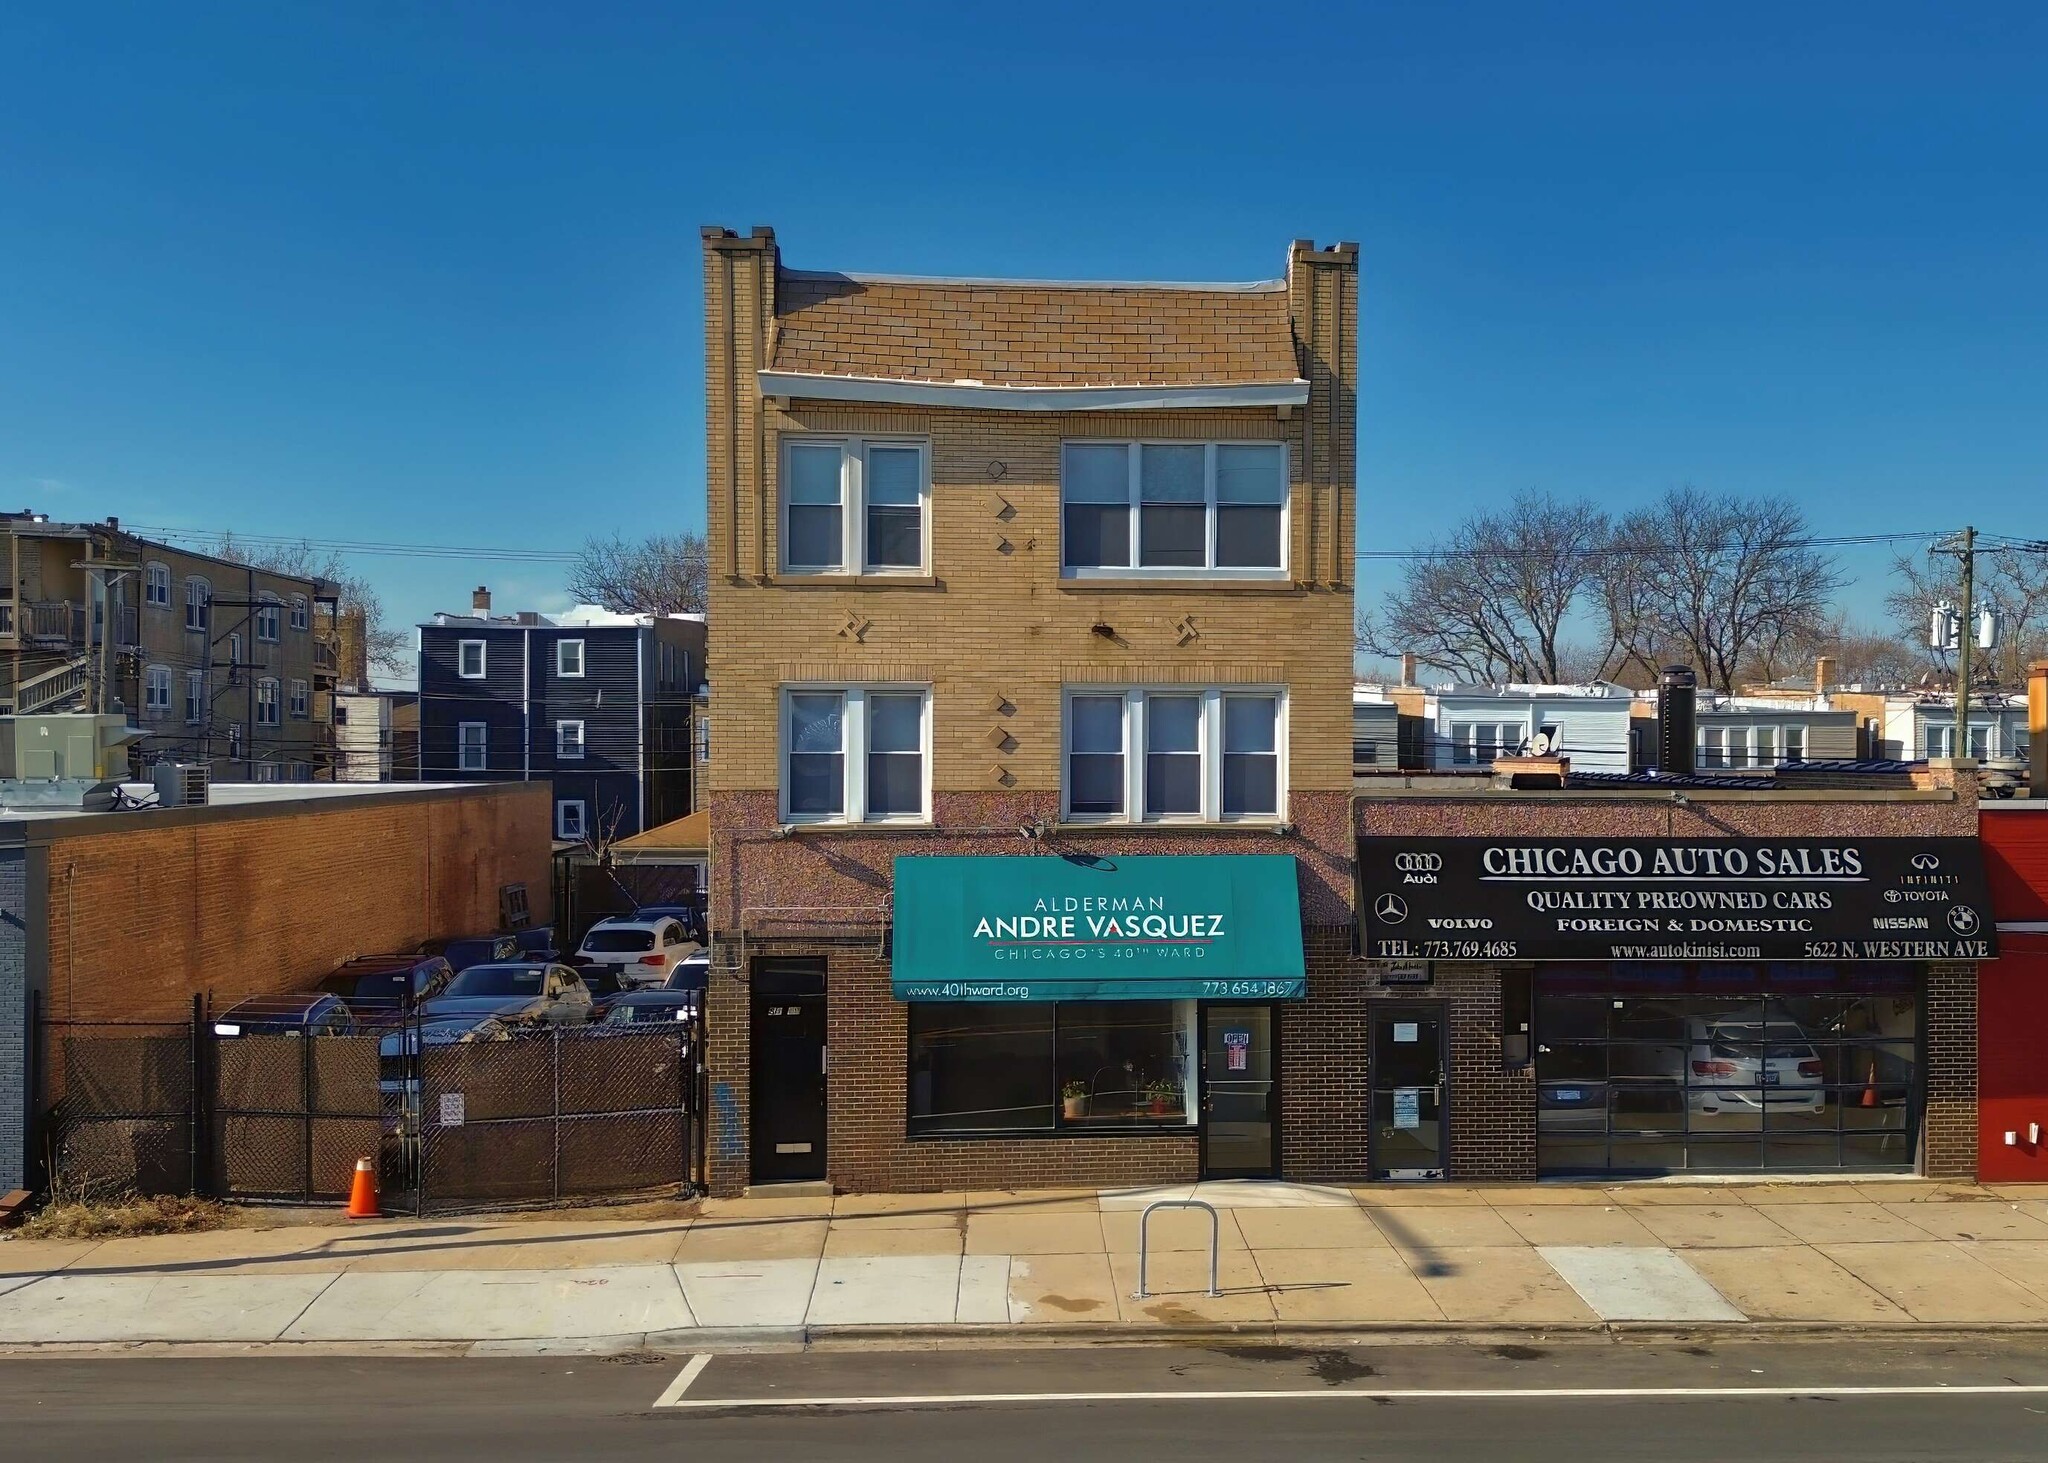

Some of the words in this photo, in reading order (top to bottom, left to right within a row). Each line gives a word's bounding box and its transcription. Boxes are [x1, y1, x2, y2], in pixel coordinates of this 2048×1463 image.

[1483, 848, 1643, 875] CHICAGO
[1652, 848, 1748, 875] AUTO
[1756, 848, 1862, 875] SALES
[1402, 873, 1438, 884] Audi
[1527, 890, 1631, 912] QUALITY
[1637, 891, 1767, 909] PREOWNED
[1773, 891, 1832, 909] CARS
[1902, 891, 1949, 901] TOYOTA
[1034, 897, 1163, 912] ALDERMAN
[973, 916, 1076, 938] ANDRE
[1086, 914, 1224, 938] VASQUEZ
[1427, 918, 1493, 929] VOLVO
[1557, 919, 1660, 932] FOREIGN
[1667, 919, 1684, 932] &
[1690, 919, 1813, 932] DOMESTIC
[1872, 917, 1929, 929] NISSAN
[994, 948, 1105, 960] CHICAGO'S
[1156, 947, 1205, 958] WARD
[1378, 940, 1419, 956] TEL:
[1424, 940, 1517, 957] 773.769.4685
[1610, 941, 1761, 958] www.autokinisi.com
[1804, 941, 1837, 958] 5622
[1863, 941, 1949, 958] WESTERN
[1954, 940, 1989, 957] AVE
